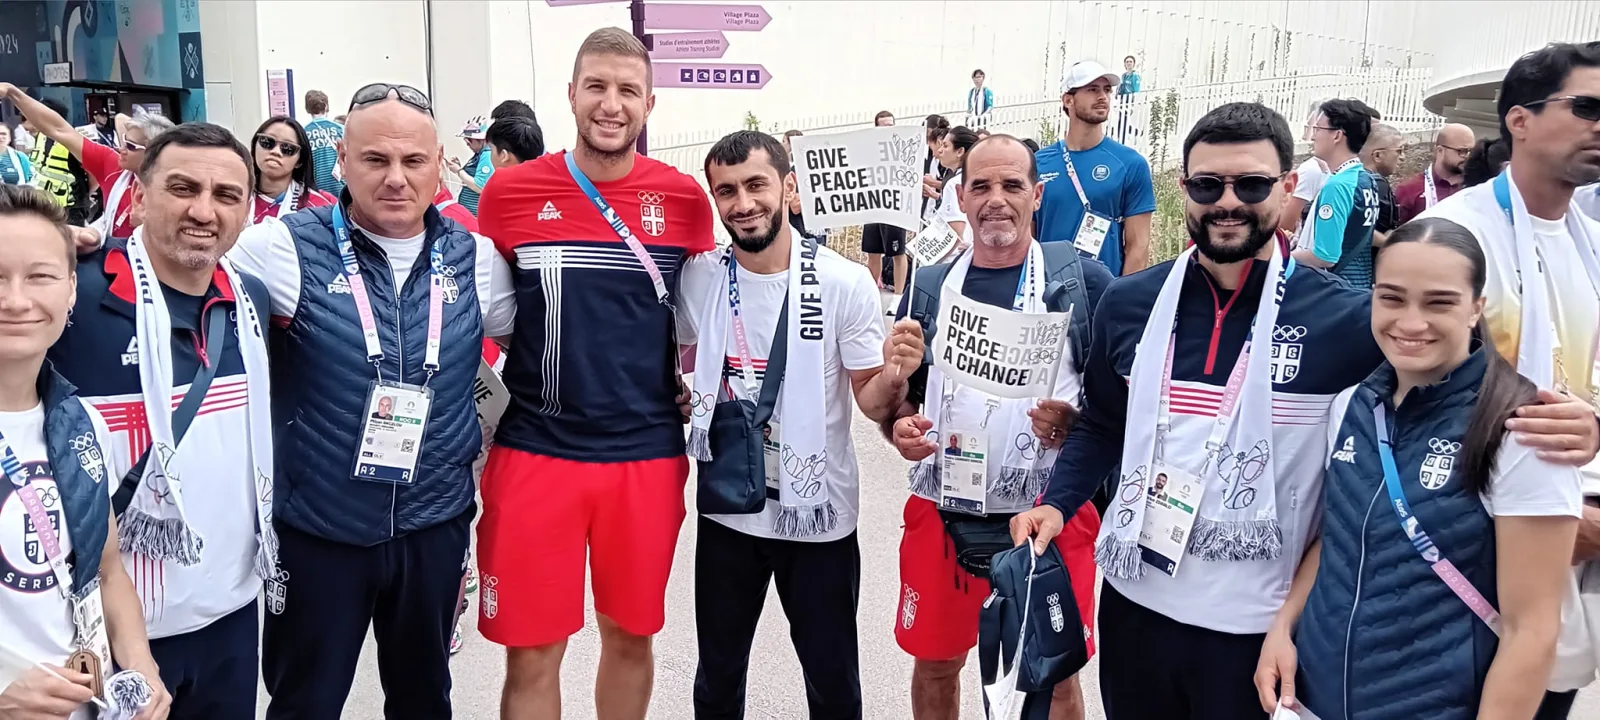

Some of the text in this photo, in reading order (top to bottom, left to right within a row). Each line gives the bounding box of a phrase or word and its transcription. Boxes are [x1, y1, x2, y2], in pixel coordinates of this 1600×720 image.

[806, 147, 849, 170] GIVE
[809, 168, 869, 193] PEACE
[814, 188, 901, 215] A CHANCE
[537, 210, 563, 221] PEAK
[930, 231, 954, 258] CHANCE
[800, 293, 824, 341] GIVE
[950, 304, 989, 336] GIVE
[946, 324, 1001, 361] PEACE
[121, 353, 139, 366] PE
[943, 345, 1030, 387] A CHANCE
[360, 466, 376, 476] A 2
[402, 471, 409, 480] R
[24, 491, 44, 522] PARIS
[1166, 562, 1174, 574] R
